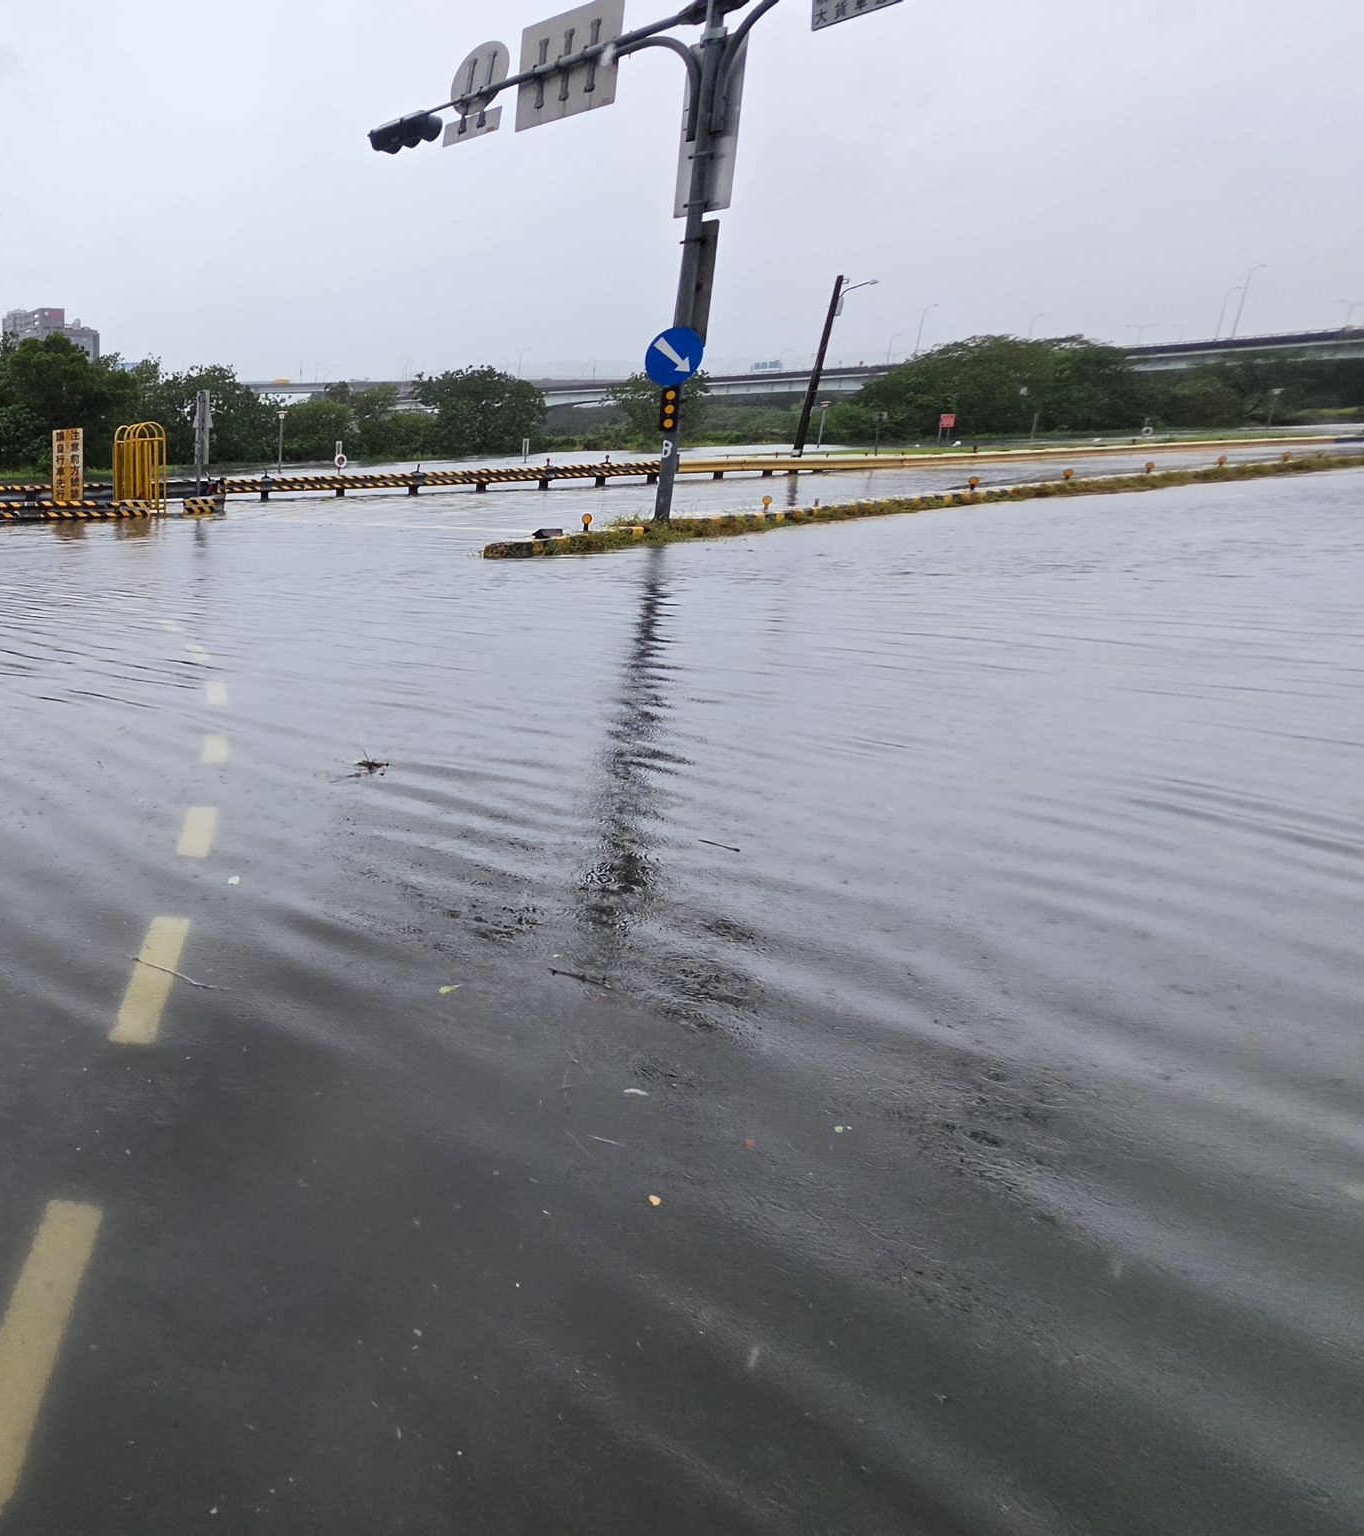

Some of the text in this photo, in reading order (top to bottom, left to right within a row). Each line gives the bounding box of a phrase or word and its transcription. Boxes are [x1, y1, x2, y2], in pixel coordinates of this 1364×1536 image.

[815, 0, 888, 25] 大貨車
[661, 440, 673, 458] B
